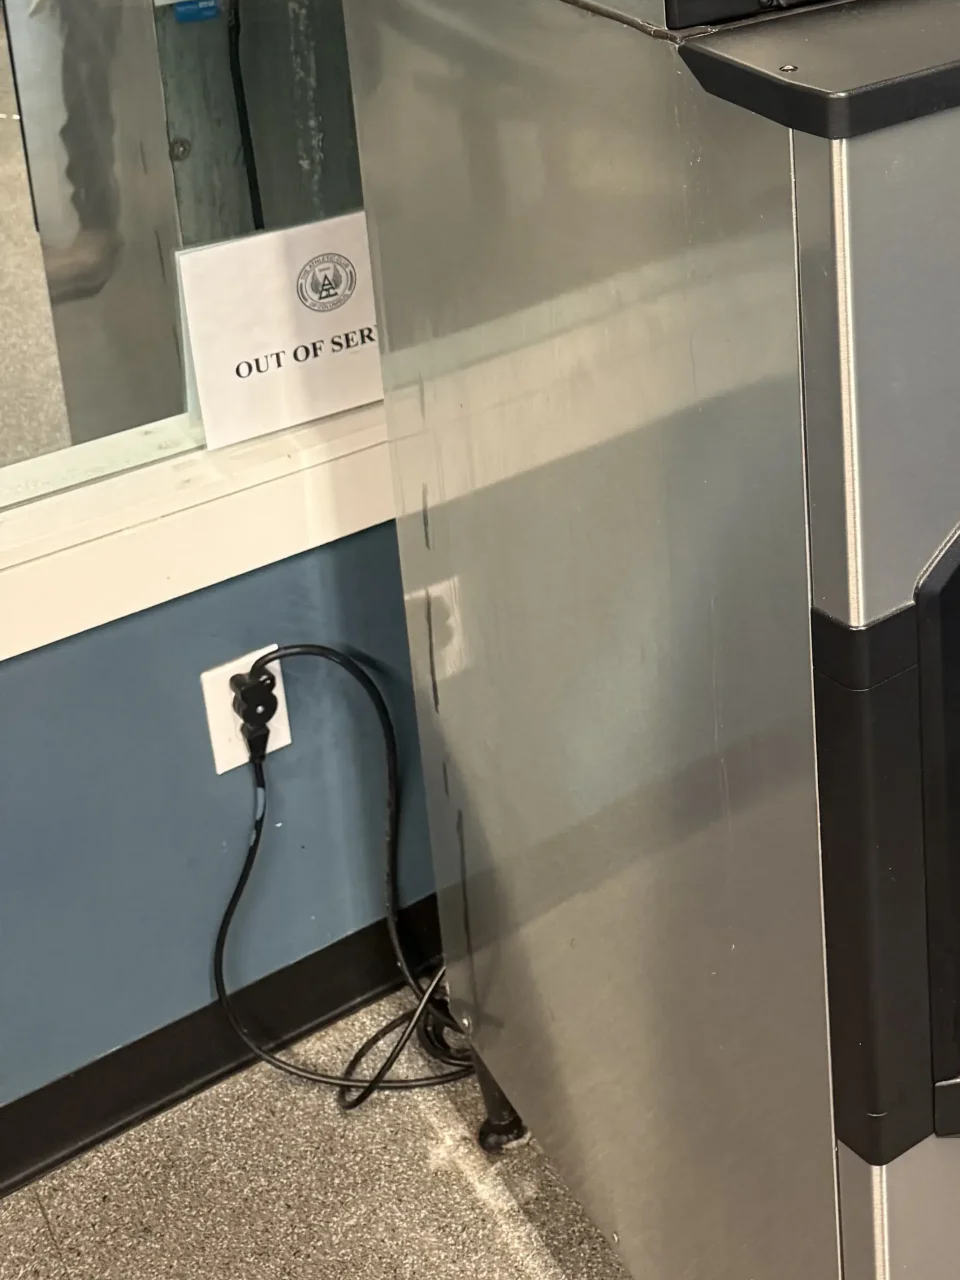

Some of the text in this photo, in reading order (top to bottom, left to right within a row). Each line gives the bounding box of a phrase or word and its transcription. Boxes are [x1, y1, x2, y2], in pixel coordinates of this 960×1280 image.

[235, 324, 378, 379] OUT OF SER
